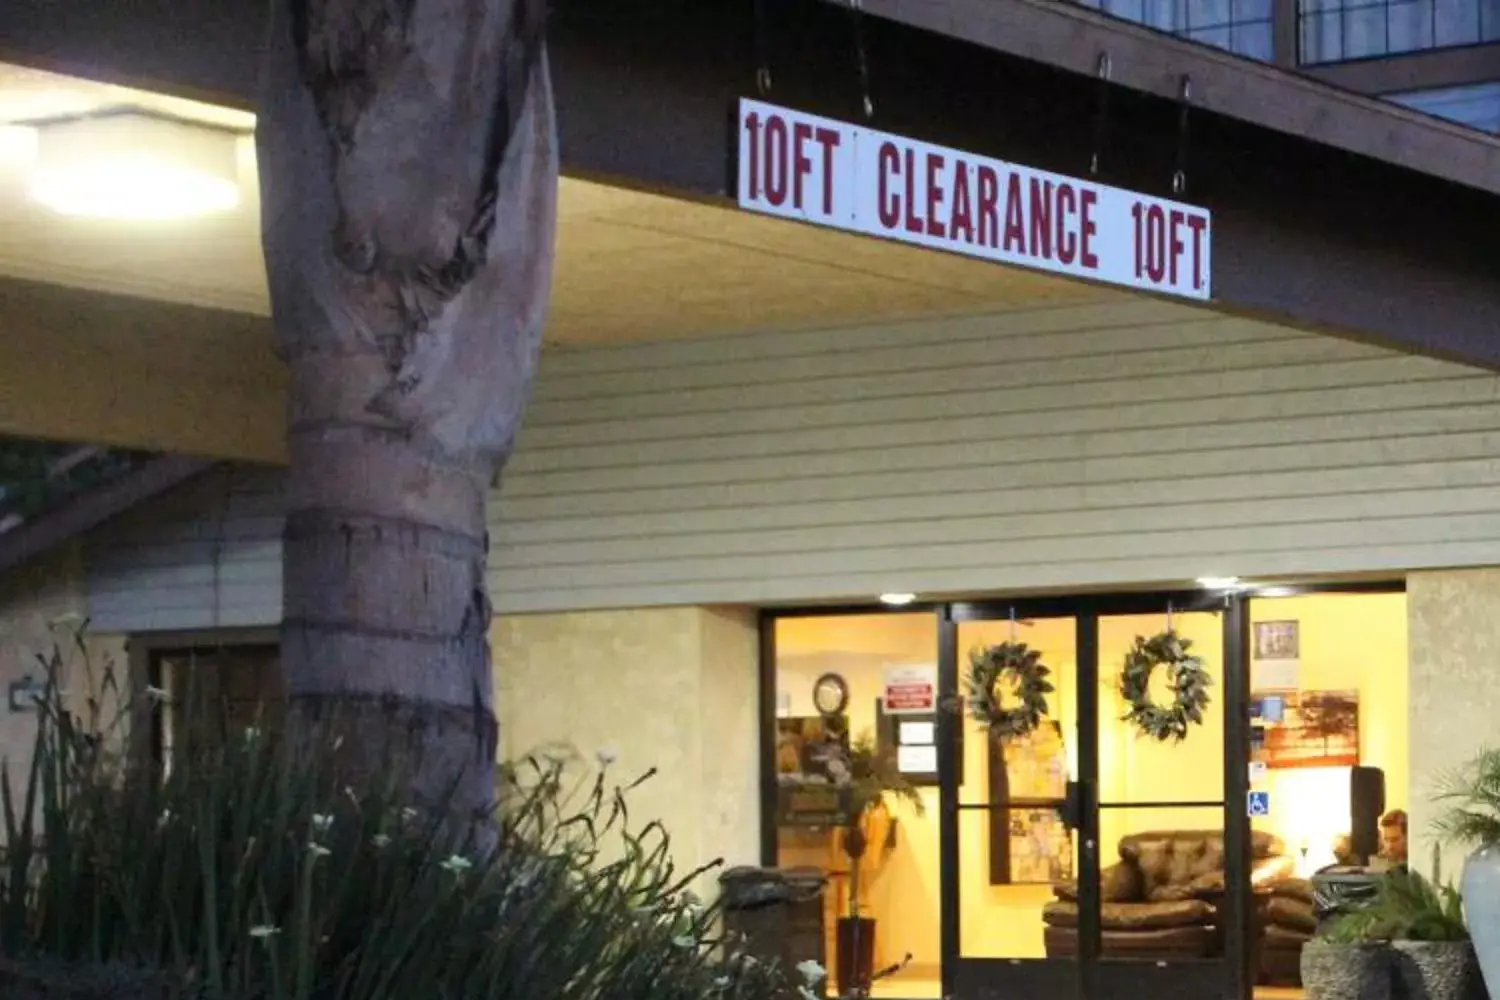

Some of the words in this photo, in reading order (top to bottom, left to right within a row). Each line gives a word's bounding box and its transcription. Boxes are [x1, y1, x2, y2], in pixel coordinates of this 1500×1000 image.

[746, 111, 840, 214] 10FT
[877, 141, 1099, 269] CLEARANCE
[1131, 201, 1207, 290] 10FT
